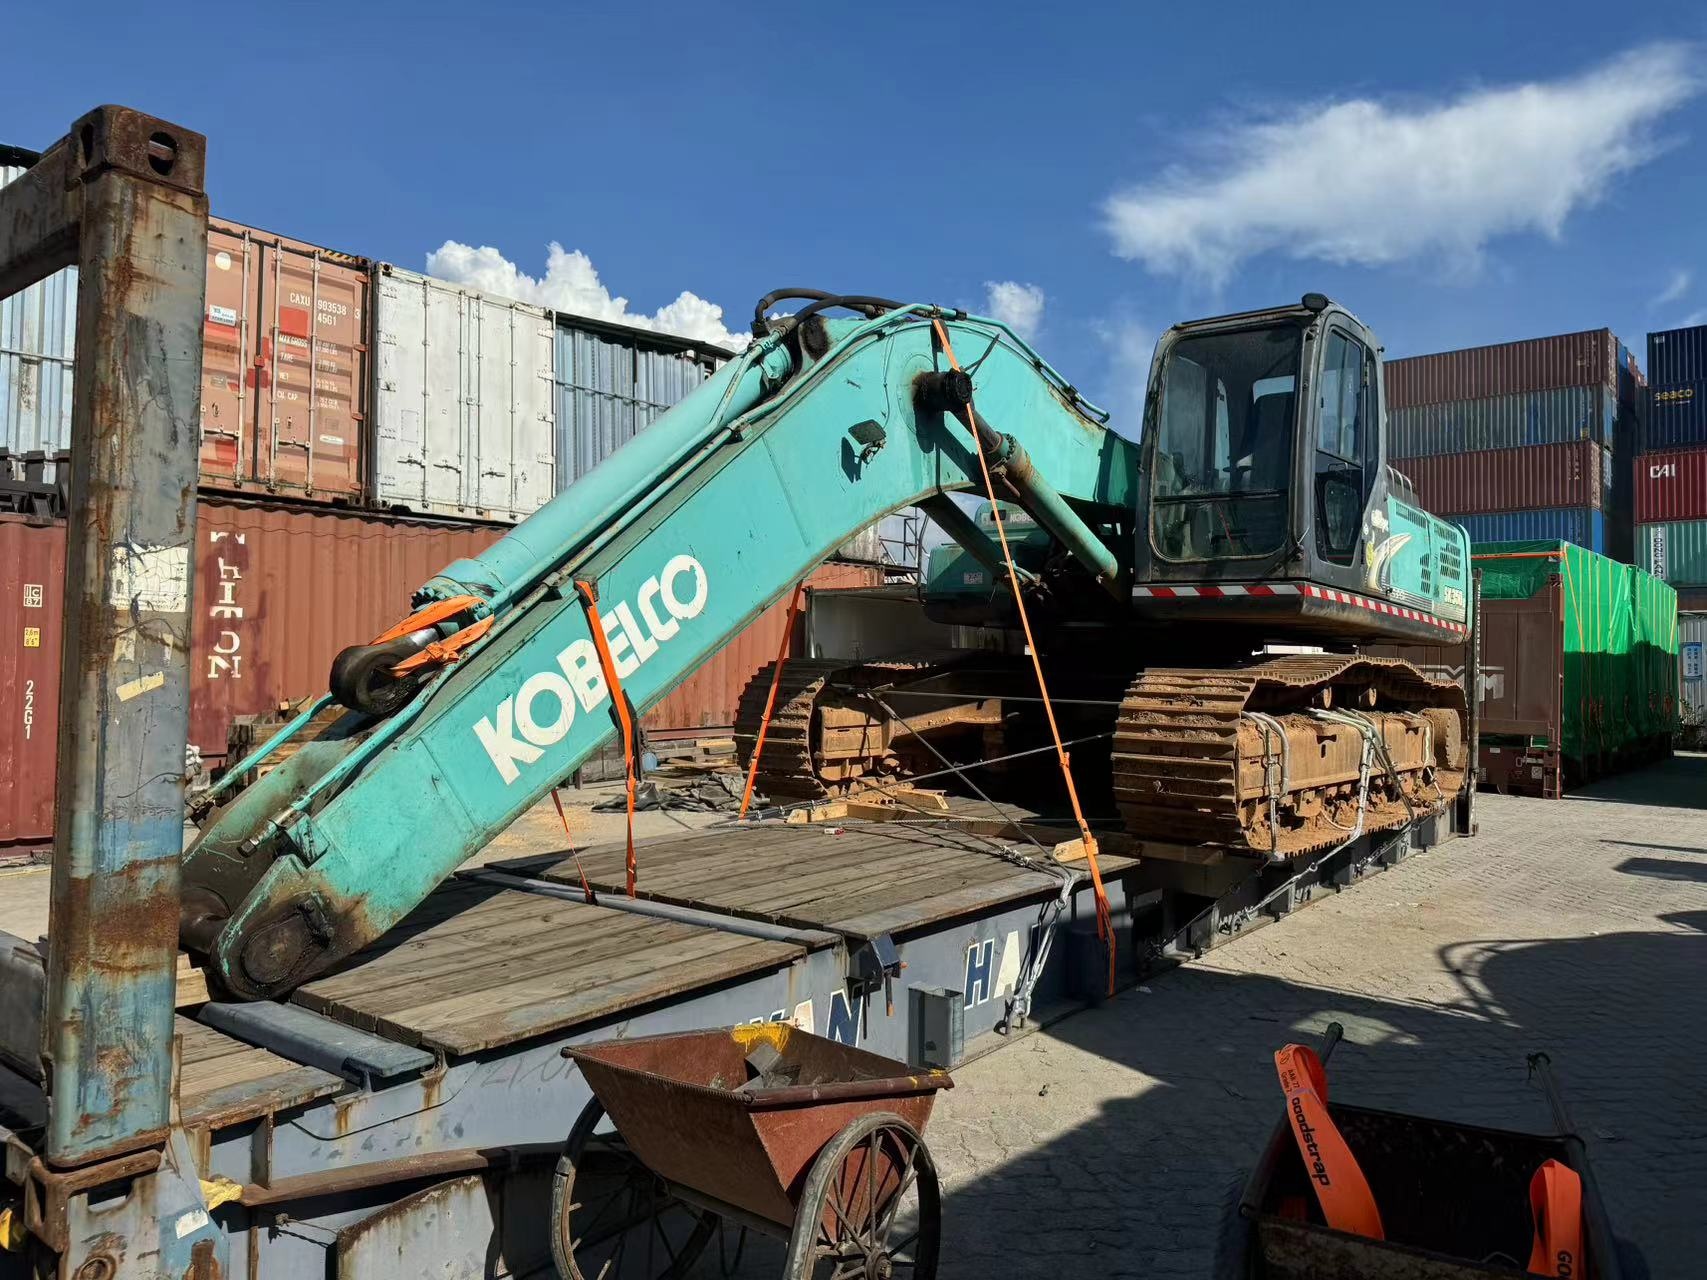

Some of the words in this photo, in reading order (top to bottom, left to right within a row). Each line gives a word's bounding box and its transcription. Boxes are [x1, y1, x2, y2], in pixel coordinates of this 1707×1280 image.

[290, 293, 311, 307] CAXU
[317, 299, 347, 316] 903538
[354, 308, 360, 320] 3
[317, 312, 337, 326] 45G1
[1654, 388, 1693, 401] seaco
[1649, 464, 1675, 479] CAI
[472, 554, 708, 786] KOBELCO
[24, 680, 34, 740] 22G1
